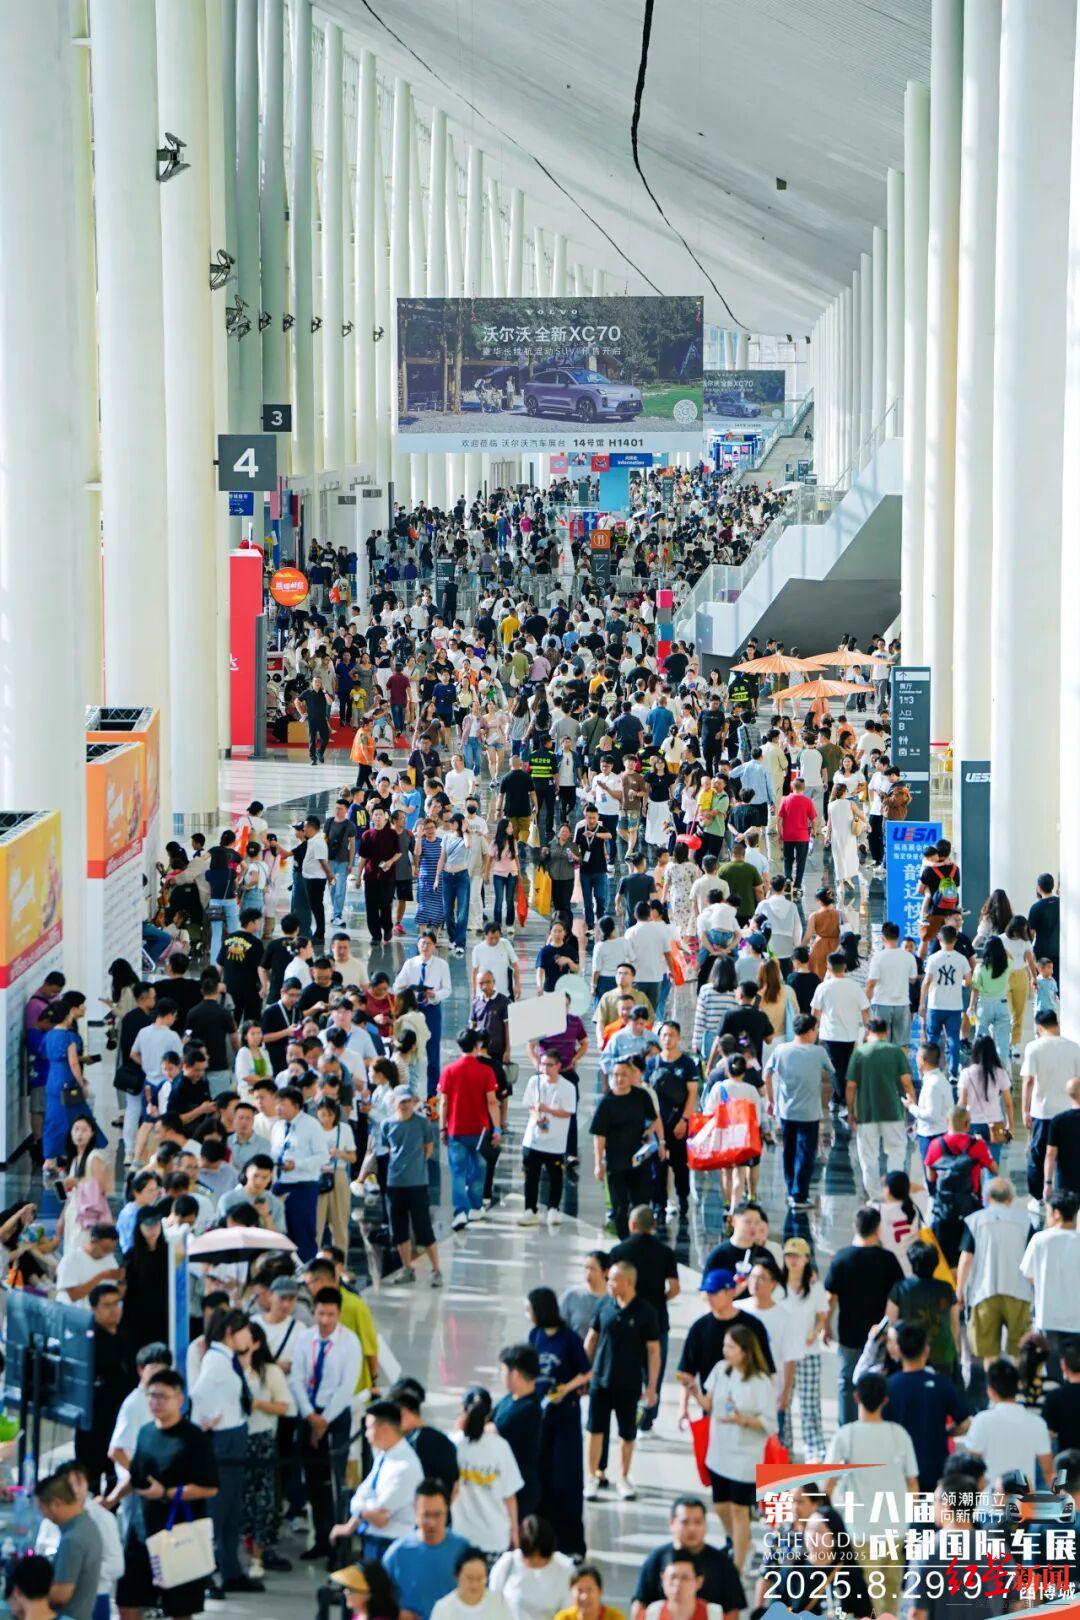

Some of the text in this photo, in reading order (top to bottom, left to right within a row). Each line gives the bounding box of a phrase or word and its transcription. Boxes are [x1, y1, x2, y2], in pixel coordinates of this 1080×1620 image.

[483, 326, 621, 342] 沃尔沃 全新XC70
[271, 410, 283, 426] 3
[461, 439, 644, 448] 欢迎莅临 沃尔沃汽车展台 14号馆 H1401
[233, 447, 259, 478] 4
[898, 722, 905, 731] B
[965, 773, 991, 782] UES
